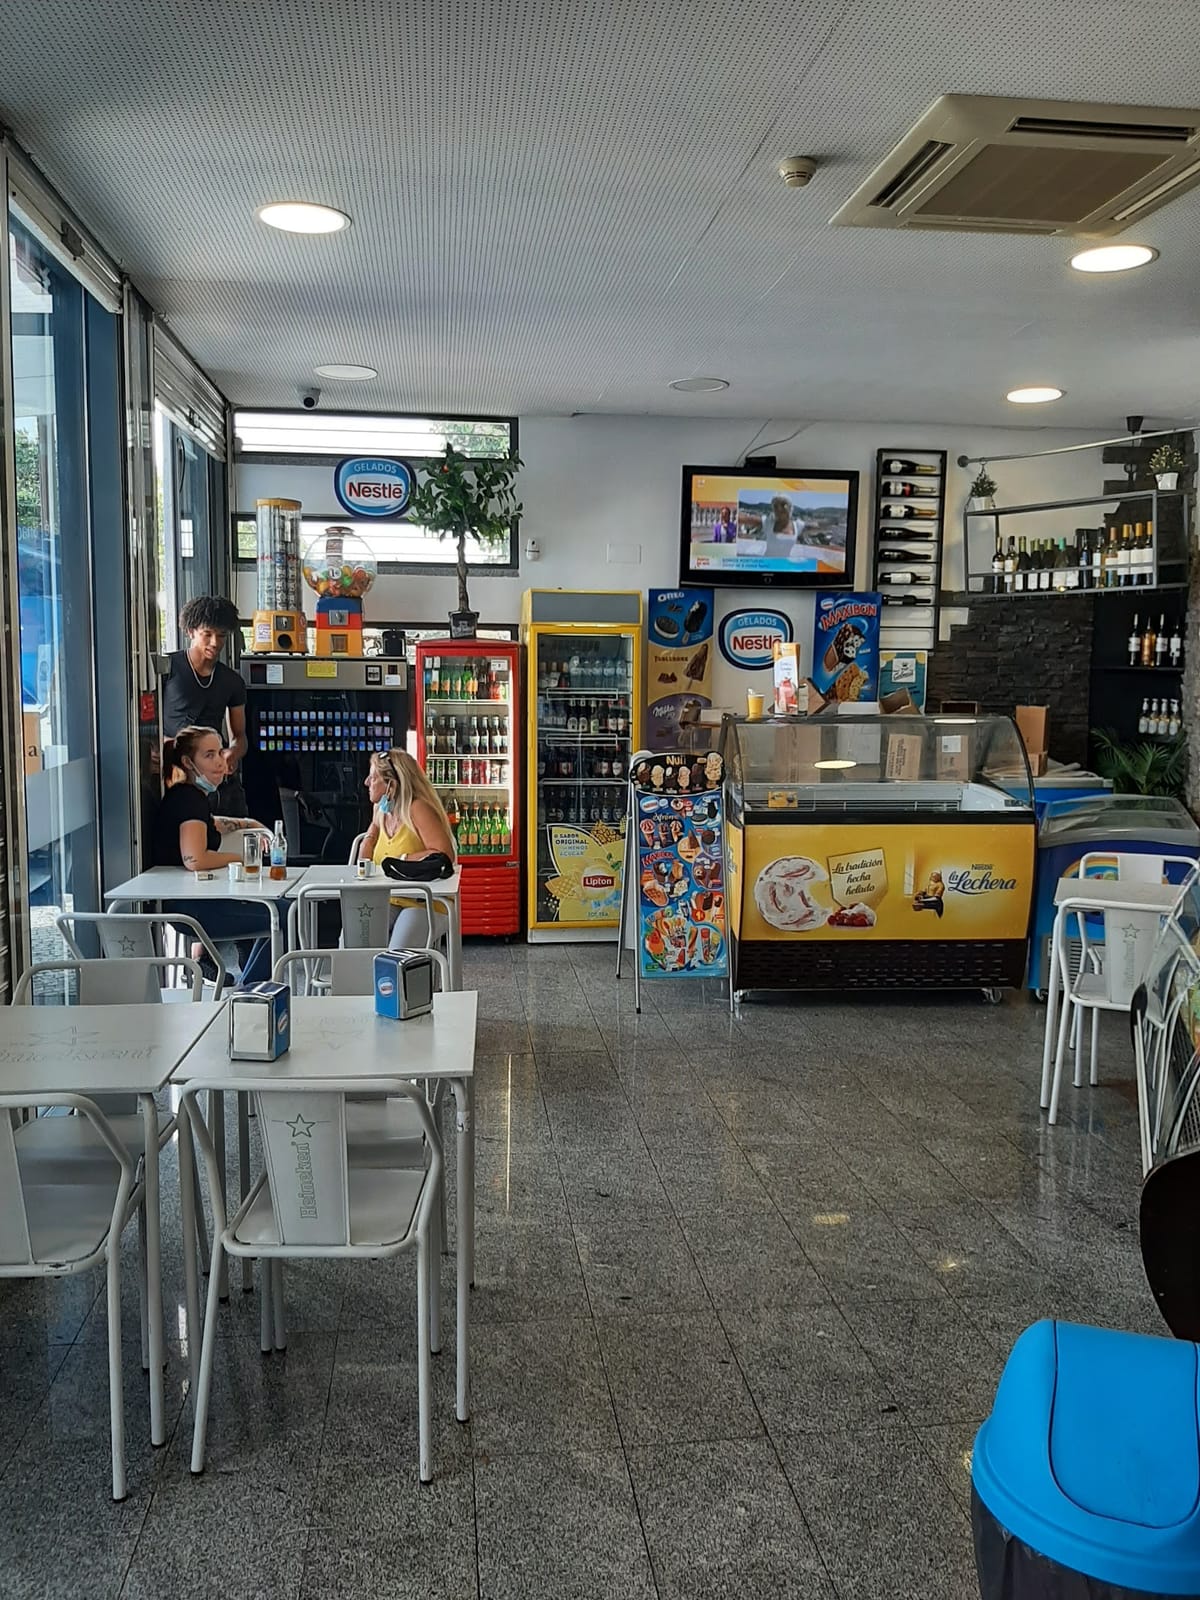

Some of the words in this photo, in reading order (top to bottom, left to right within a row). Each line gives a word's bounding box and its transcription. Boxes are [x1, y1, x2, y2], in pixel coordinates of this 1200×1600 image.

[353, 462, 397, 474] GELADOS
[657, 592, 685, 602] OREO
[738, 616, 777, 628] GELADOS
[820, 603, 877, 632] MAXIBON
[585, 877, 613, 887] Lipton
[846, 871, 872, 884] hecha
[949, 871, 1017, 895] Lechera
[845, 883, 876, 896] helado
[294, 1140, 319, 1220] Heineken
